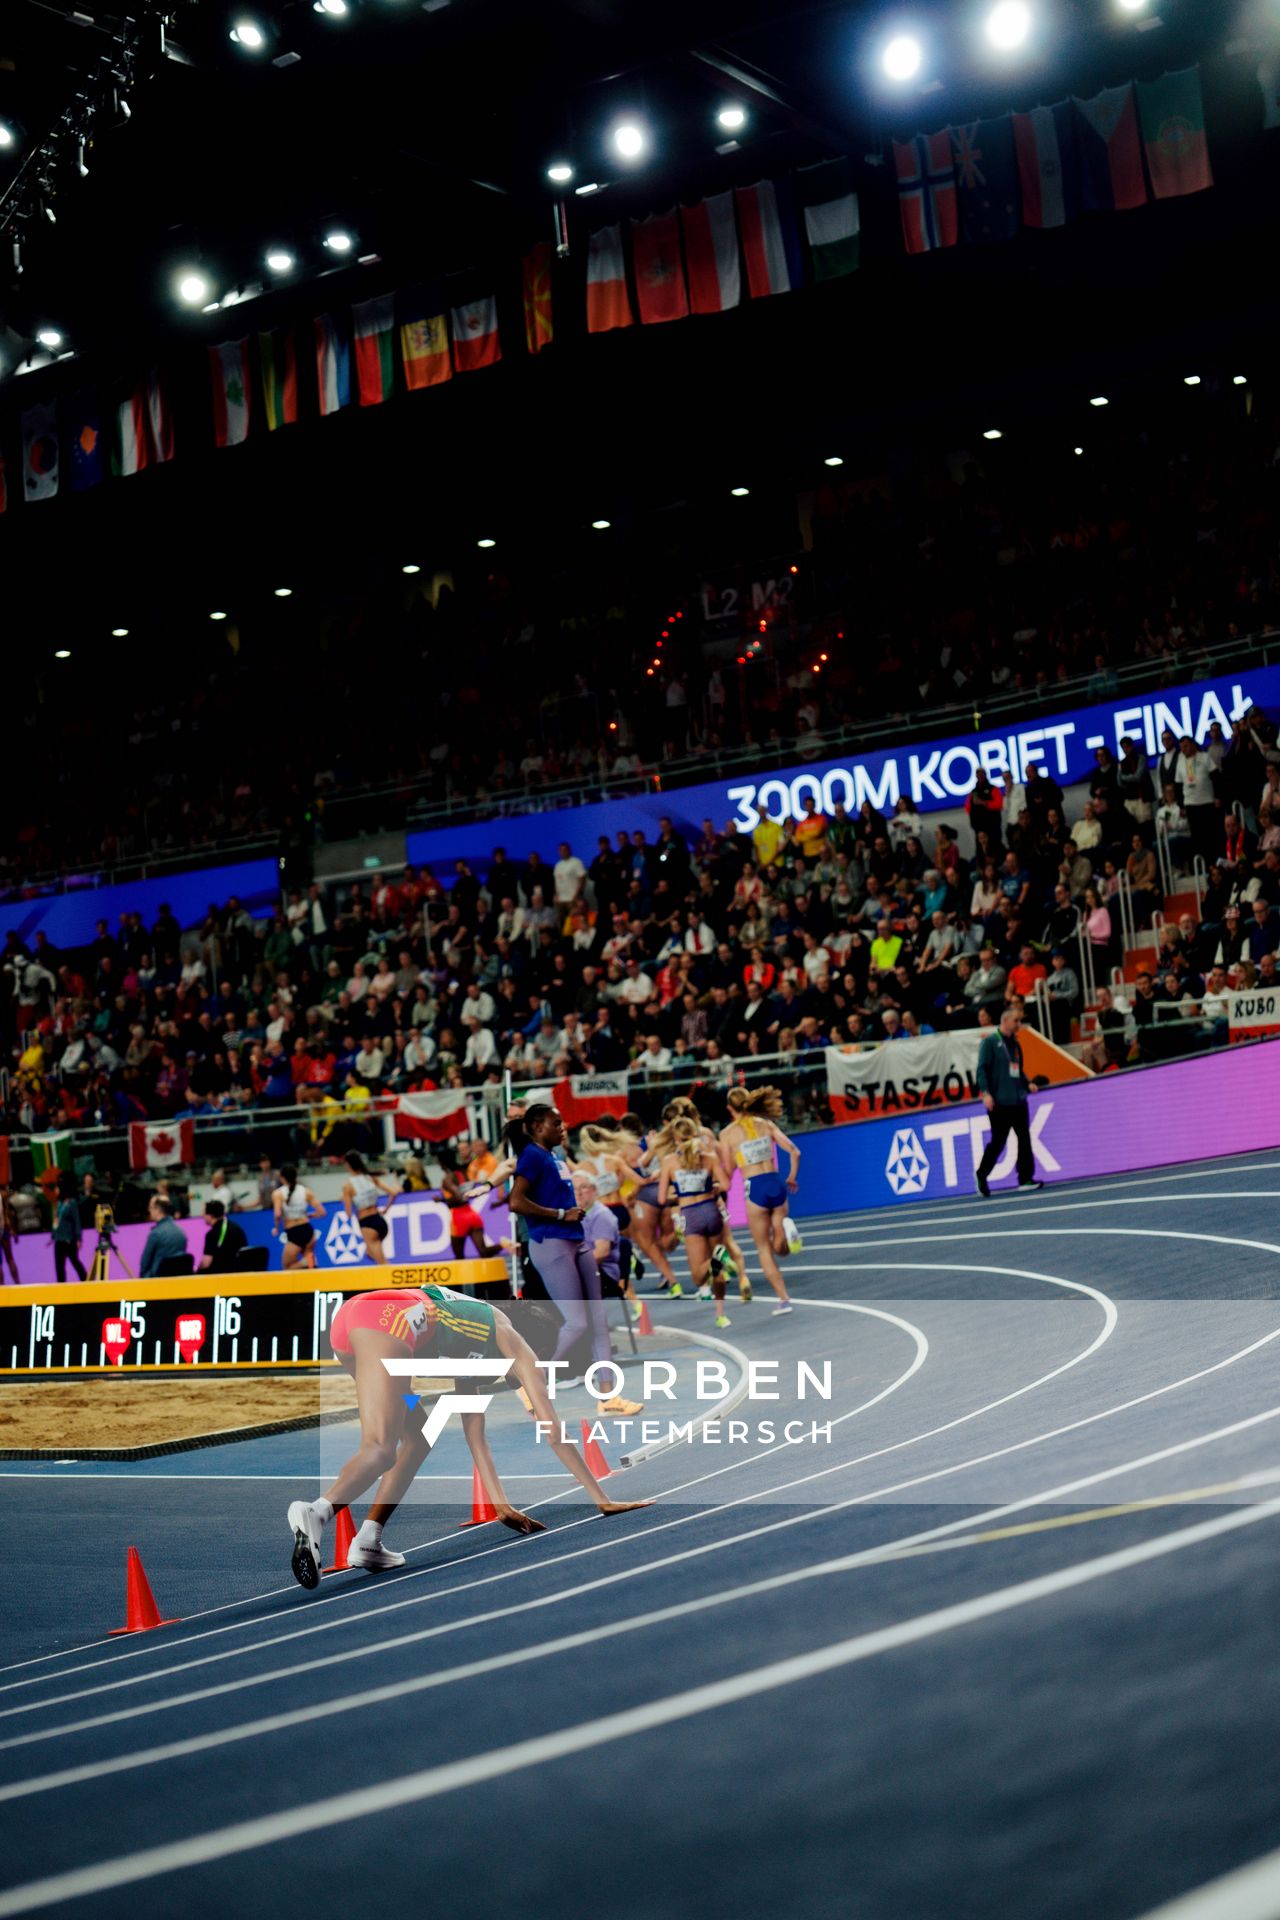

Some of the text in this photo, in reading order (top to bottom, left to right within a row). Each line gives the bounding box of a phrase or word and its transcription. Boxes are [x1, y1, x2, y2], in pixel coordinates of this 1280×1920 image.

[702, 581, 739, 620] L2
[727, 758, 900, 834] 3000M
[908, 722, 1075, 803] KOBIET
[1113, 684, 1253, 761] FINAŁ
[923, 1102, 1062, 1188] TDK
[391, 1267, 452, 1285] SEIKO
[35, 1291, 344, 1342] 14 15 16 17
[105, 1322, 127, 1344] WL
[178, 1319, 202, 1341] WR
